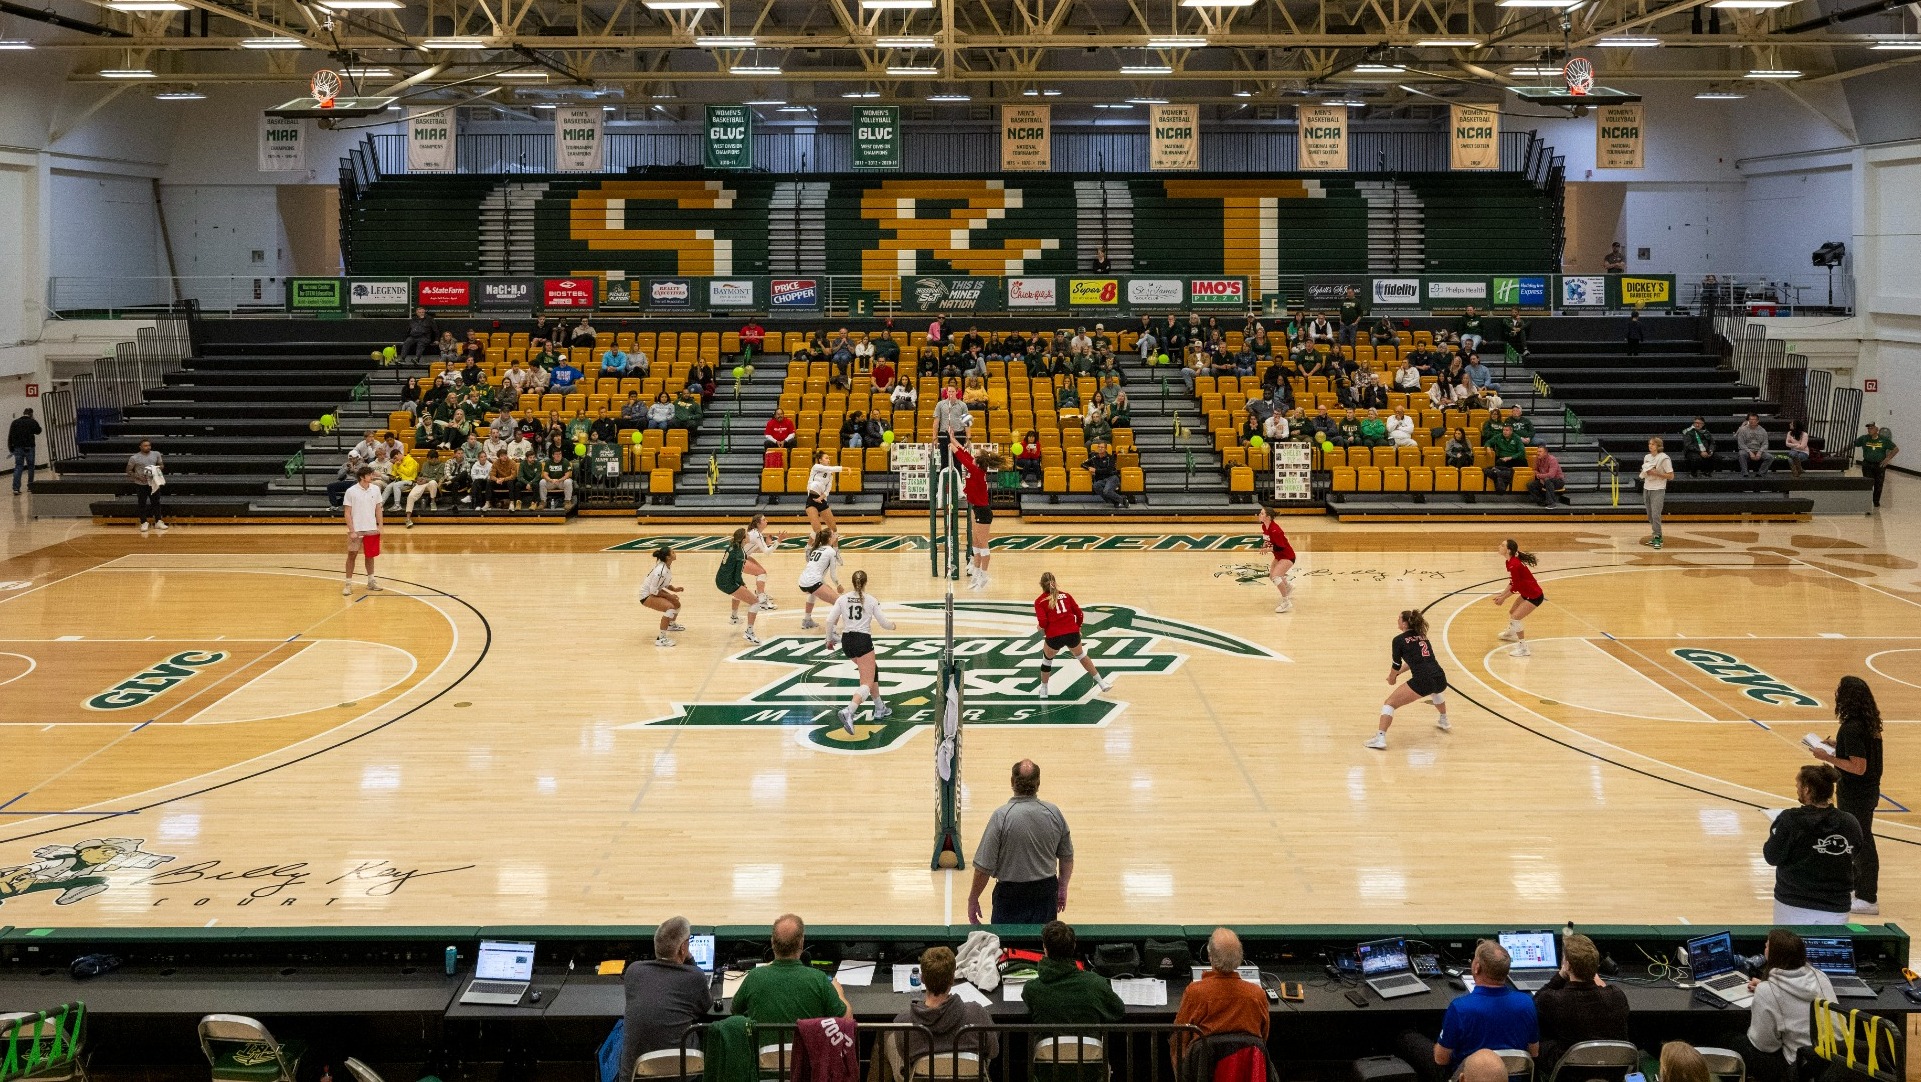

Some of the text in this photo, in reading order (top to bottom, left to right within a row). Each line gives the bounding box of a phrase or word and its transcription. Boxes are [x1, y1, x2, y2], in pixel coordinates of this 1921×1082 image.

[266, 130, 298, 141] MIAA
[414, 128, 447, 140] MIAA
[563, 128, 595, 140] MIAA
[711, 127, 745, 140] GLVC
[858, 127, 893, 140] GLVC
[1007, 127, 1044, 140] NCAA
[1155, 127, 1192, 140] NCAA
[1304, 127, 1341, 139] NCAA
[1456, 127, 1493, 139] NCAA
[1601, 126, 1639, 139] NCAA
[371, 285, 406, 295] LEGENDS
[713, 287, 751, 296] BAYMONT
[774, 281, 800, 294] PRICE
[951, 280, 985, 290] THIS IS
[1072, 282, 1101, 296] Super
[1192, 281, 1241, 295] IMO'S
[1384, 283, 1417, 297] fidelity
[1445, 286, 1485, 295] Phelps Health
[1626, 282, 1664, 293] DICKEY'S
[773, 289, 815, 304] CHOPPER
[917, 293, 941, 302] S&T
[948, 290, 981, 300] MINER
[1099, 282, 1118, 303] 8
[857, 299, 865, 314] E
[938, 299, 977, 309] NATION
[1271, 298, 1278, 314] F
[27, 386, 37, 395] G1
[1866, 382, 1877, 391] G2
[986, 534, 1265, 552] ARENA
[809, 551, 822, 562] 20
[848, 605, 863, 621] 13
[1055, 599, 1068, 615] 11
[1418, 641, 1430, 657] 2
[87, 650, 226, 710] GLVC
[1672, 648, 1821, 708] GLVC
[130, 860, 310, 898] Billy
[152, 897, 340, 907] COURT
